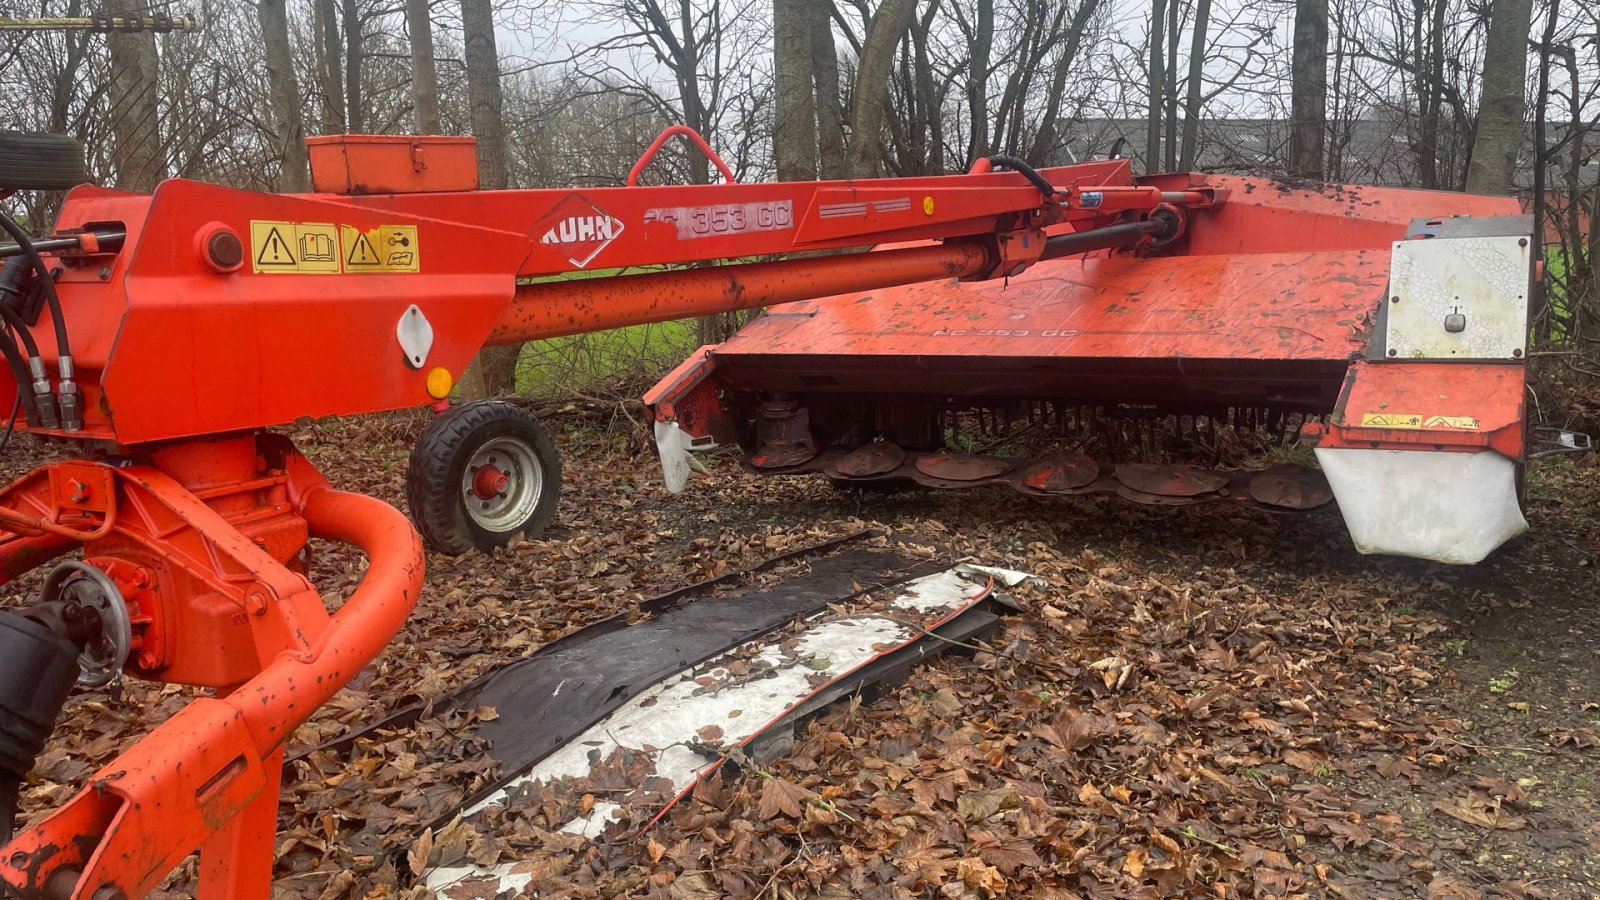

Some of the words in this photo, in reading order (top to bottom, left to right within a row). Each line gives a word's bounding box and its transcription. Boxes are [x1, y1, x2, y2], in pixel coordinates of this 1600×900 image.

[692, 206, 746, 234] 353
[758, 201, 789, 227] GC
[932, 329, 967, 337] FC
[977, 329, 1030, 337] 353
[1041, 329, 1078, 337] GC
